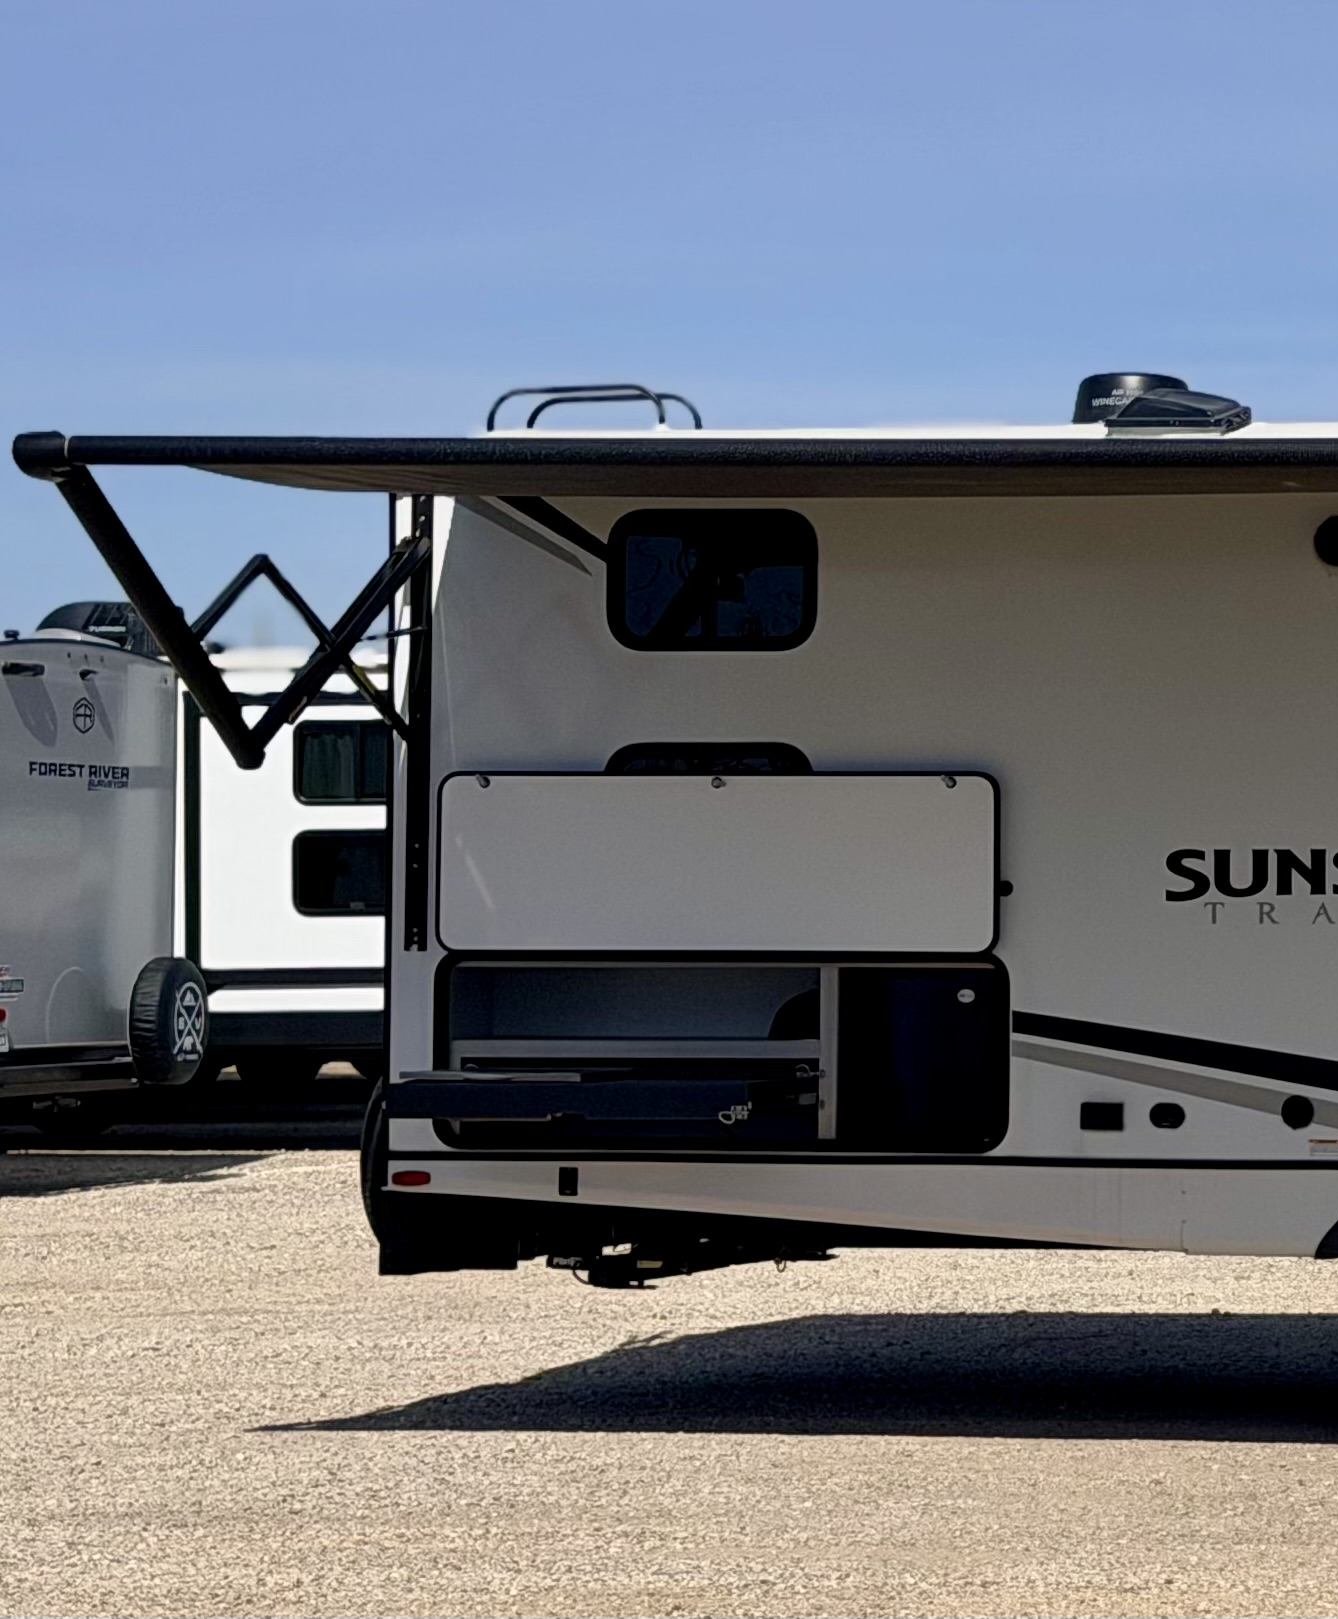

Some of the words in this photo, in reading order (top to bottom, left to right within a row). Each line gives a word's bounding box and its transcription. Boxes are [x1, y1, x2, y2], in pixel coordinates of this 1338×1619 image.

[1091, 396, 1131, 406] WINEGA
[28, 761, 85, 778] FOREST
[88, 764, 130, 780] RIVER
